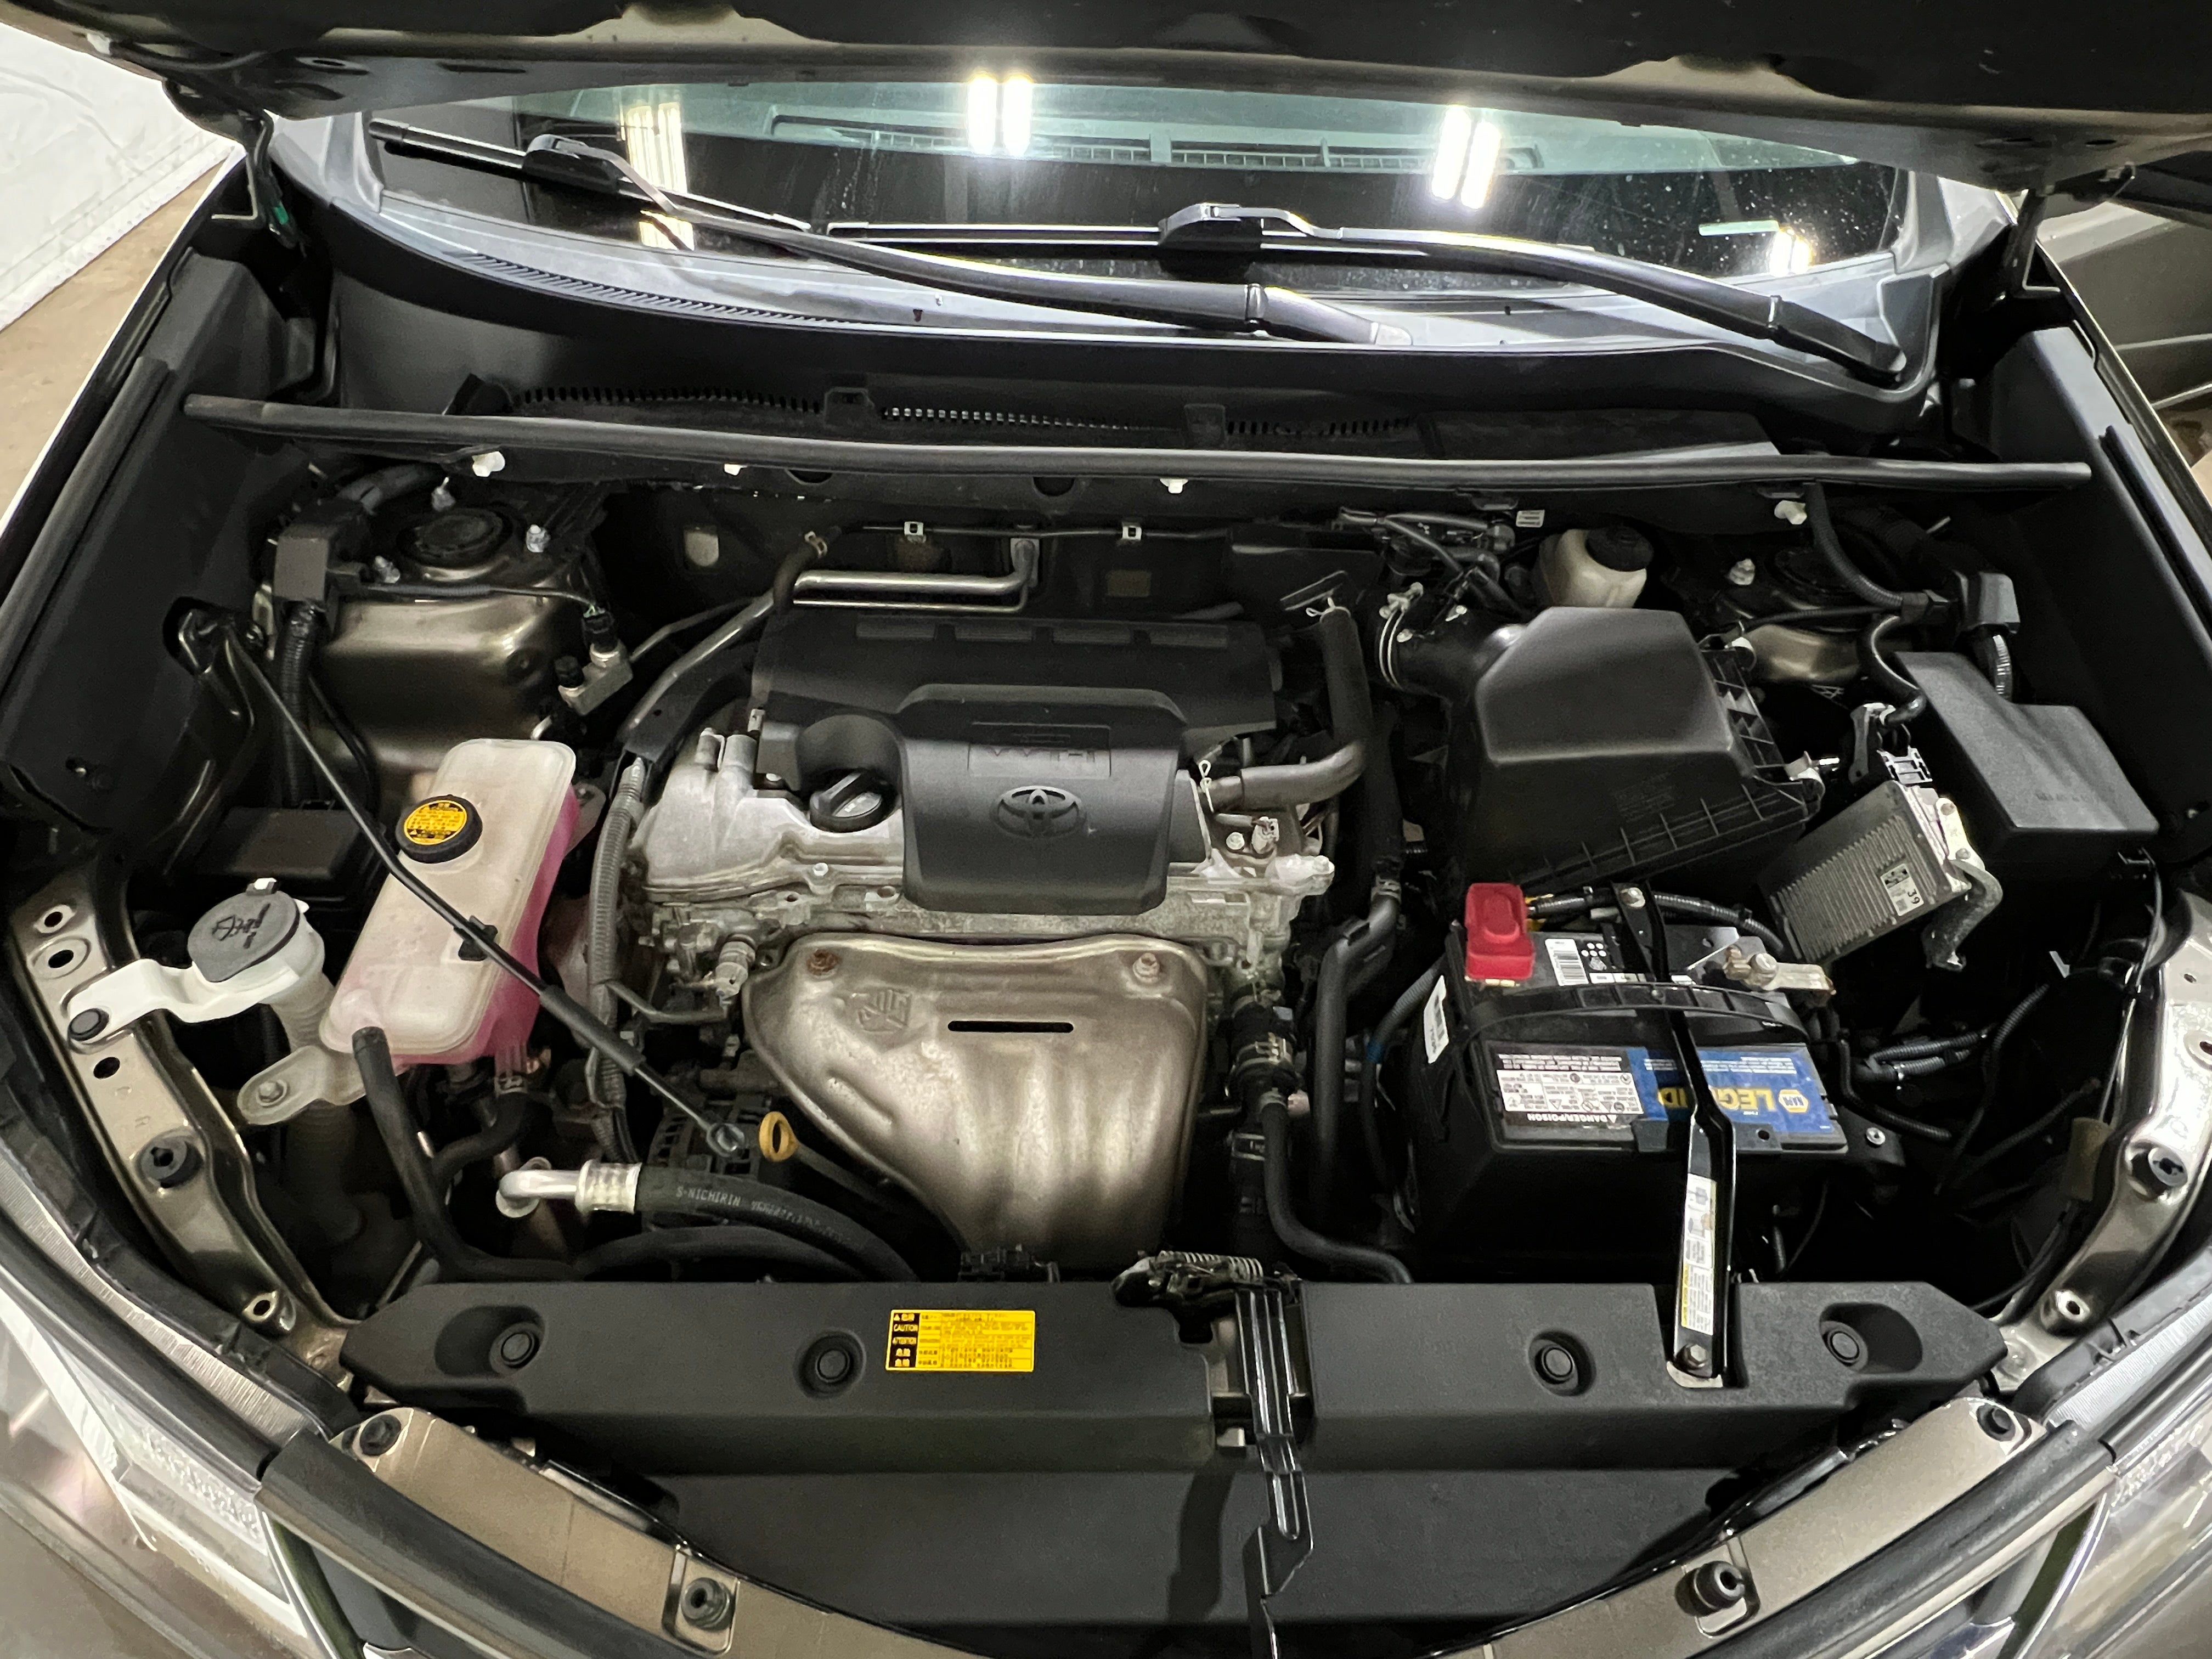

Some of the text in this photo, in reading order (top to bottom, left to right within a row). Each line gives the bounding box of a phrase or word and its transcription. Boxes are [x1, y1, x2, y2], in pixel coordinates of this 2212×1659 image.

[1908, 889, 1920, 904] 39
[1527, 1113, 1608, 1122] DANGER/POISON
[893, 1323, 918, 1332] CAUTION
